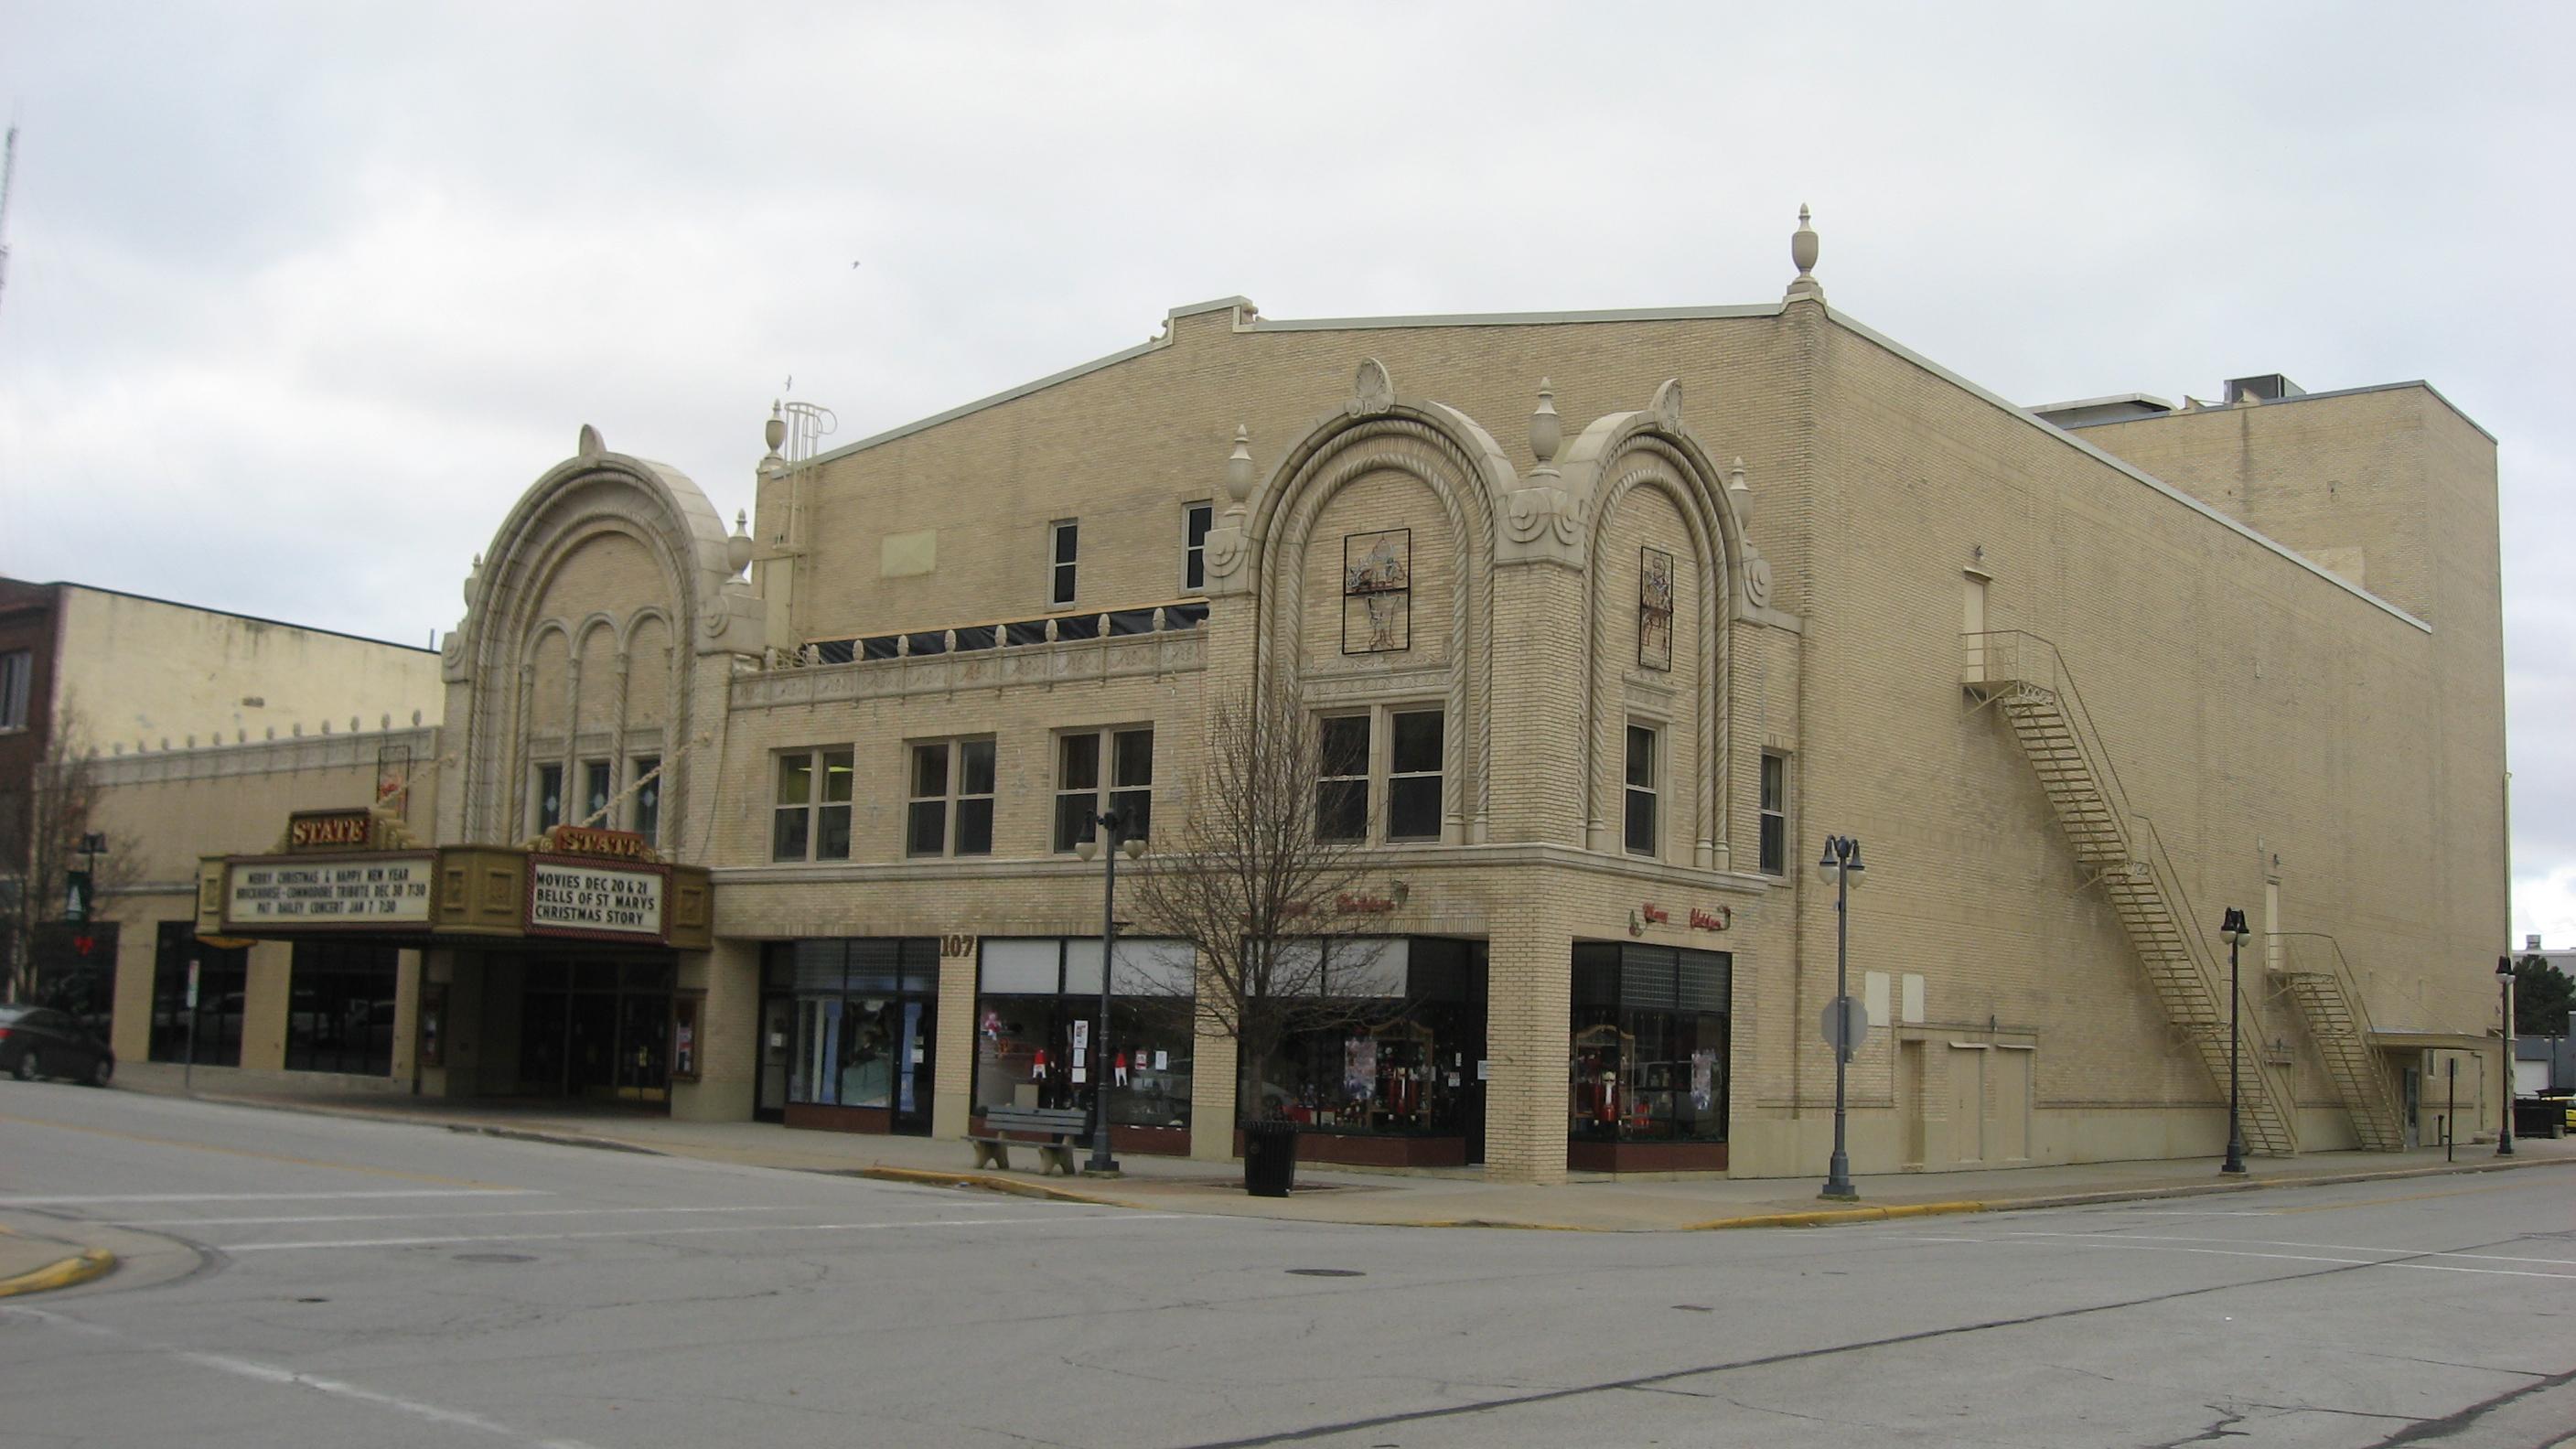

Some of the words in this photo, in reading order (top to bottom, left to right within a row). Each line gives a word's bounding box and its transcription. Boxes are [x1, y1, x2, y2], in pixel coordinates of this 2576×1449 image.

[293, 819, 364, 845] STATE
[565, 832, 642, 855] STATE
[337, 870, 362, 883] HAPPY
[368, 869, 383, 882] NEW
[388, 868, 409, 881] YEAR
[536, 872, 580, 889] MOVIES
[585, 877, 607, 892] DEC
[611, 878, 625, 893] 20
[638, 881, 648, 895] 21
[374, 885, 390, 897] DEC
[392, 884, 403, 896] 30
[536, 888, 573, 905] BELLS
[578, 892, 593, 905] OF
[596, 894, 609, 907] ST
[616, 896, 655, 911] MARYS
[310, 901, 344, 914] CONCERT
[349, 901, 365, 914] JAN
[535, 904, 602, 923] CHRISTMAS
[606, 910, 644, 926] STORY
[940, 934, 974, 958] 107
